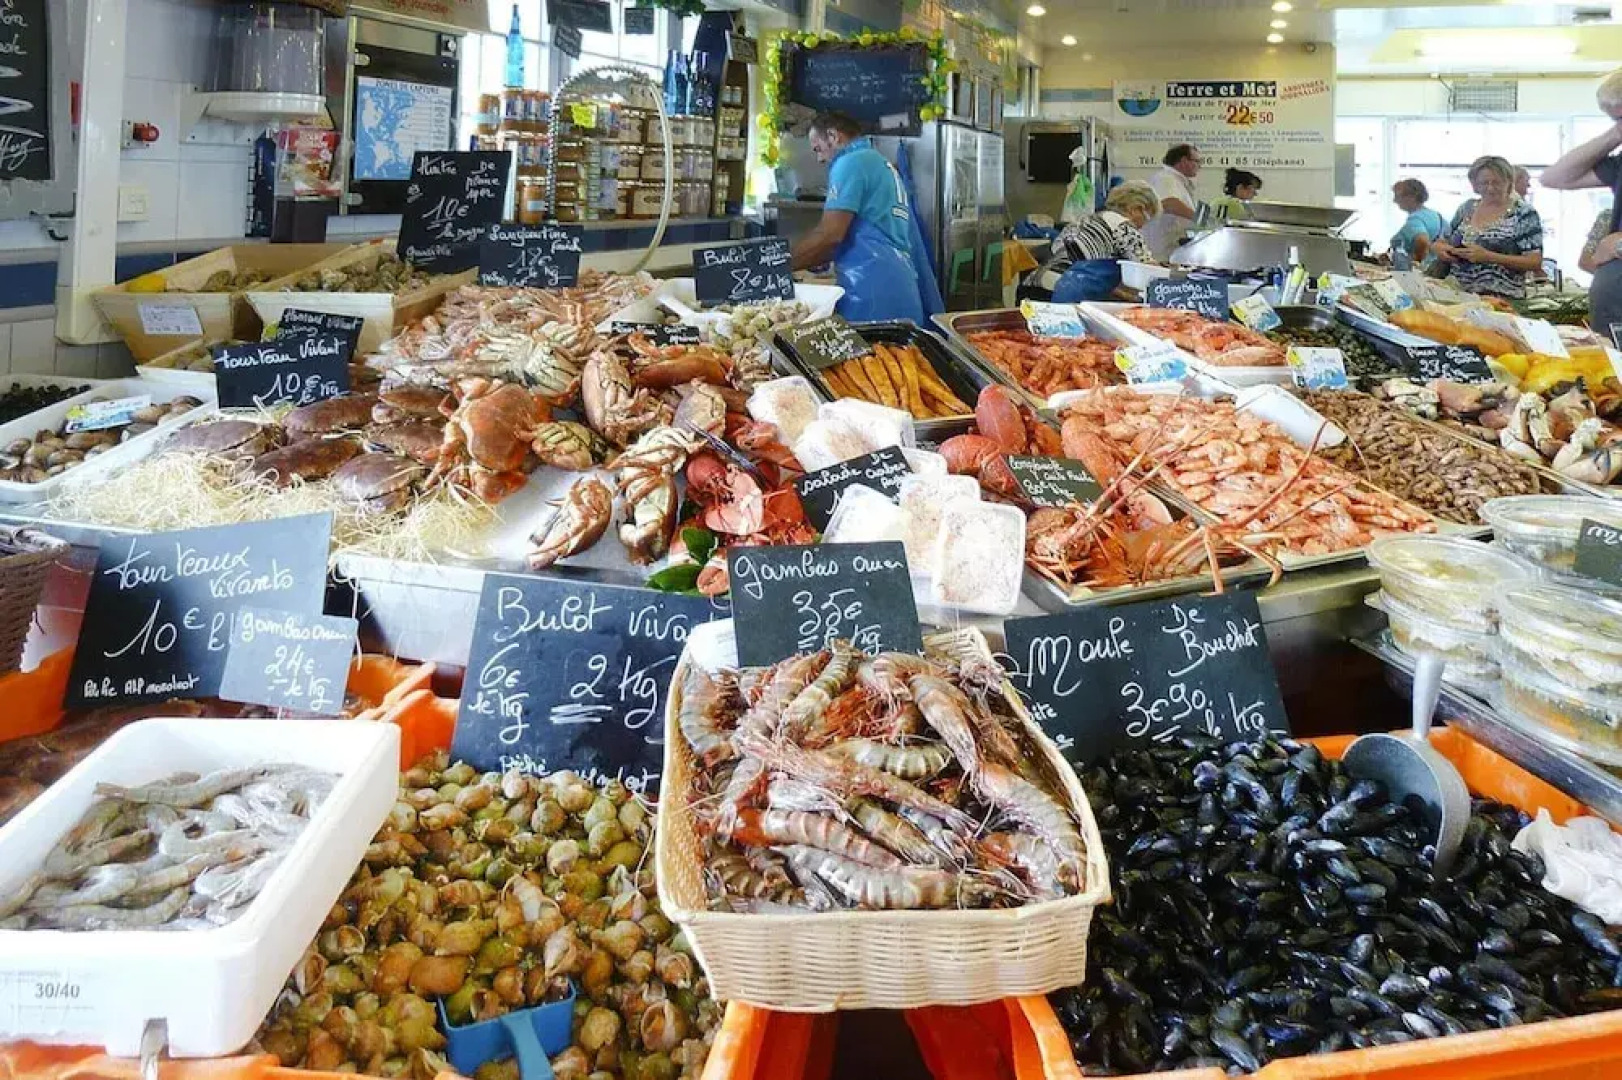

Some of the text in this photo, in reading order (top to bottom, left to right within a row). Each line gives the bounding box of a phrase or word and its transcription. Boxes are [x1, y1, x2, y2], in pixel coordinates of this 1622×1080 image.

[1167, 83, 1276, 97] Terre et Mer
[1188, 114, 1214, 123] partir
[700, 246, 753, 268] Bulot
[735, 550, 839, 600] gambas
[104, 600, 206, 658] 10€
[493, 587, 613, 642] Bulot
[792, 588, 863, 636] 35€
[570, 655, 677, 729] 2 Kg
[34, 981, 81, 999] 30/40
